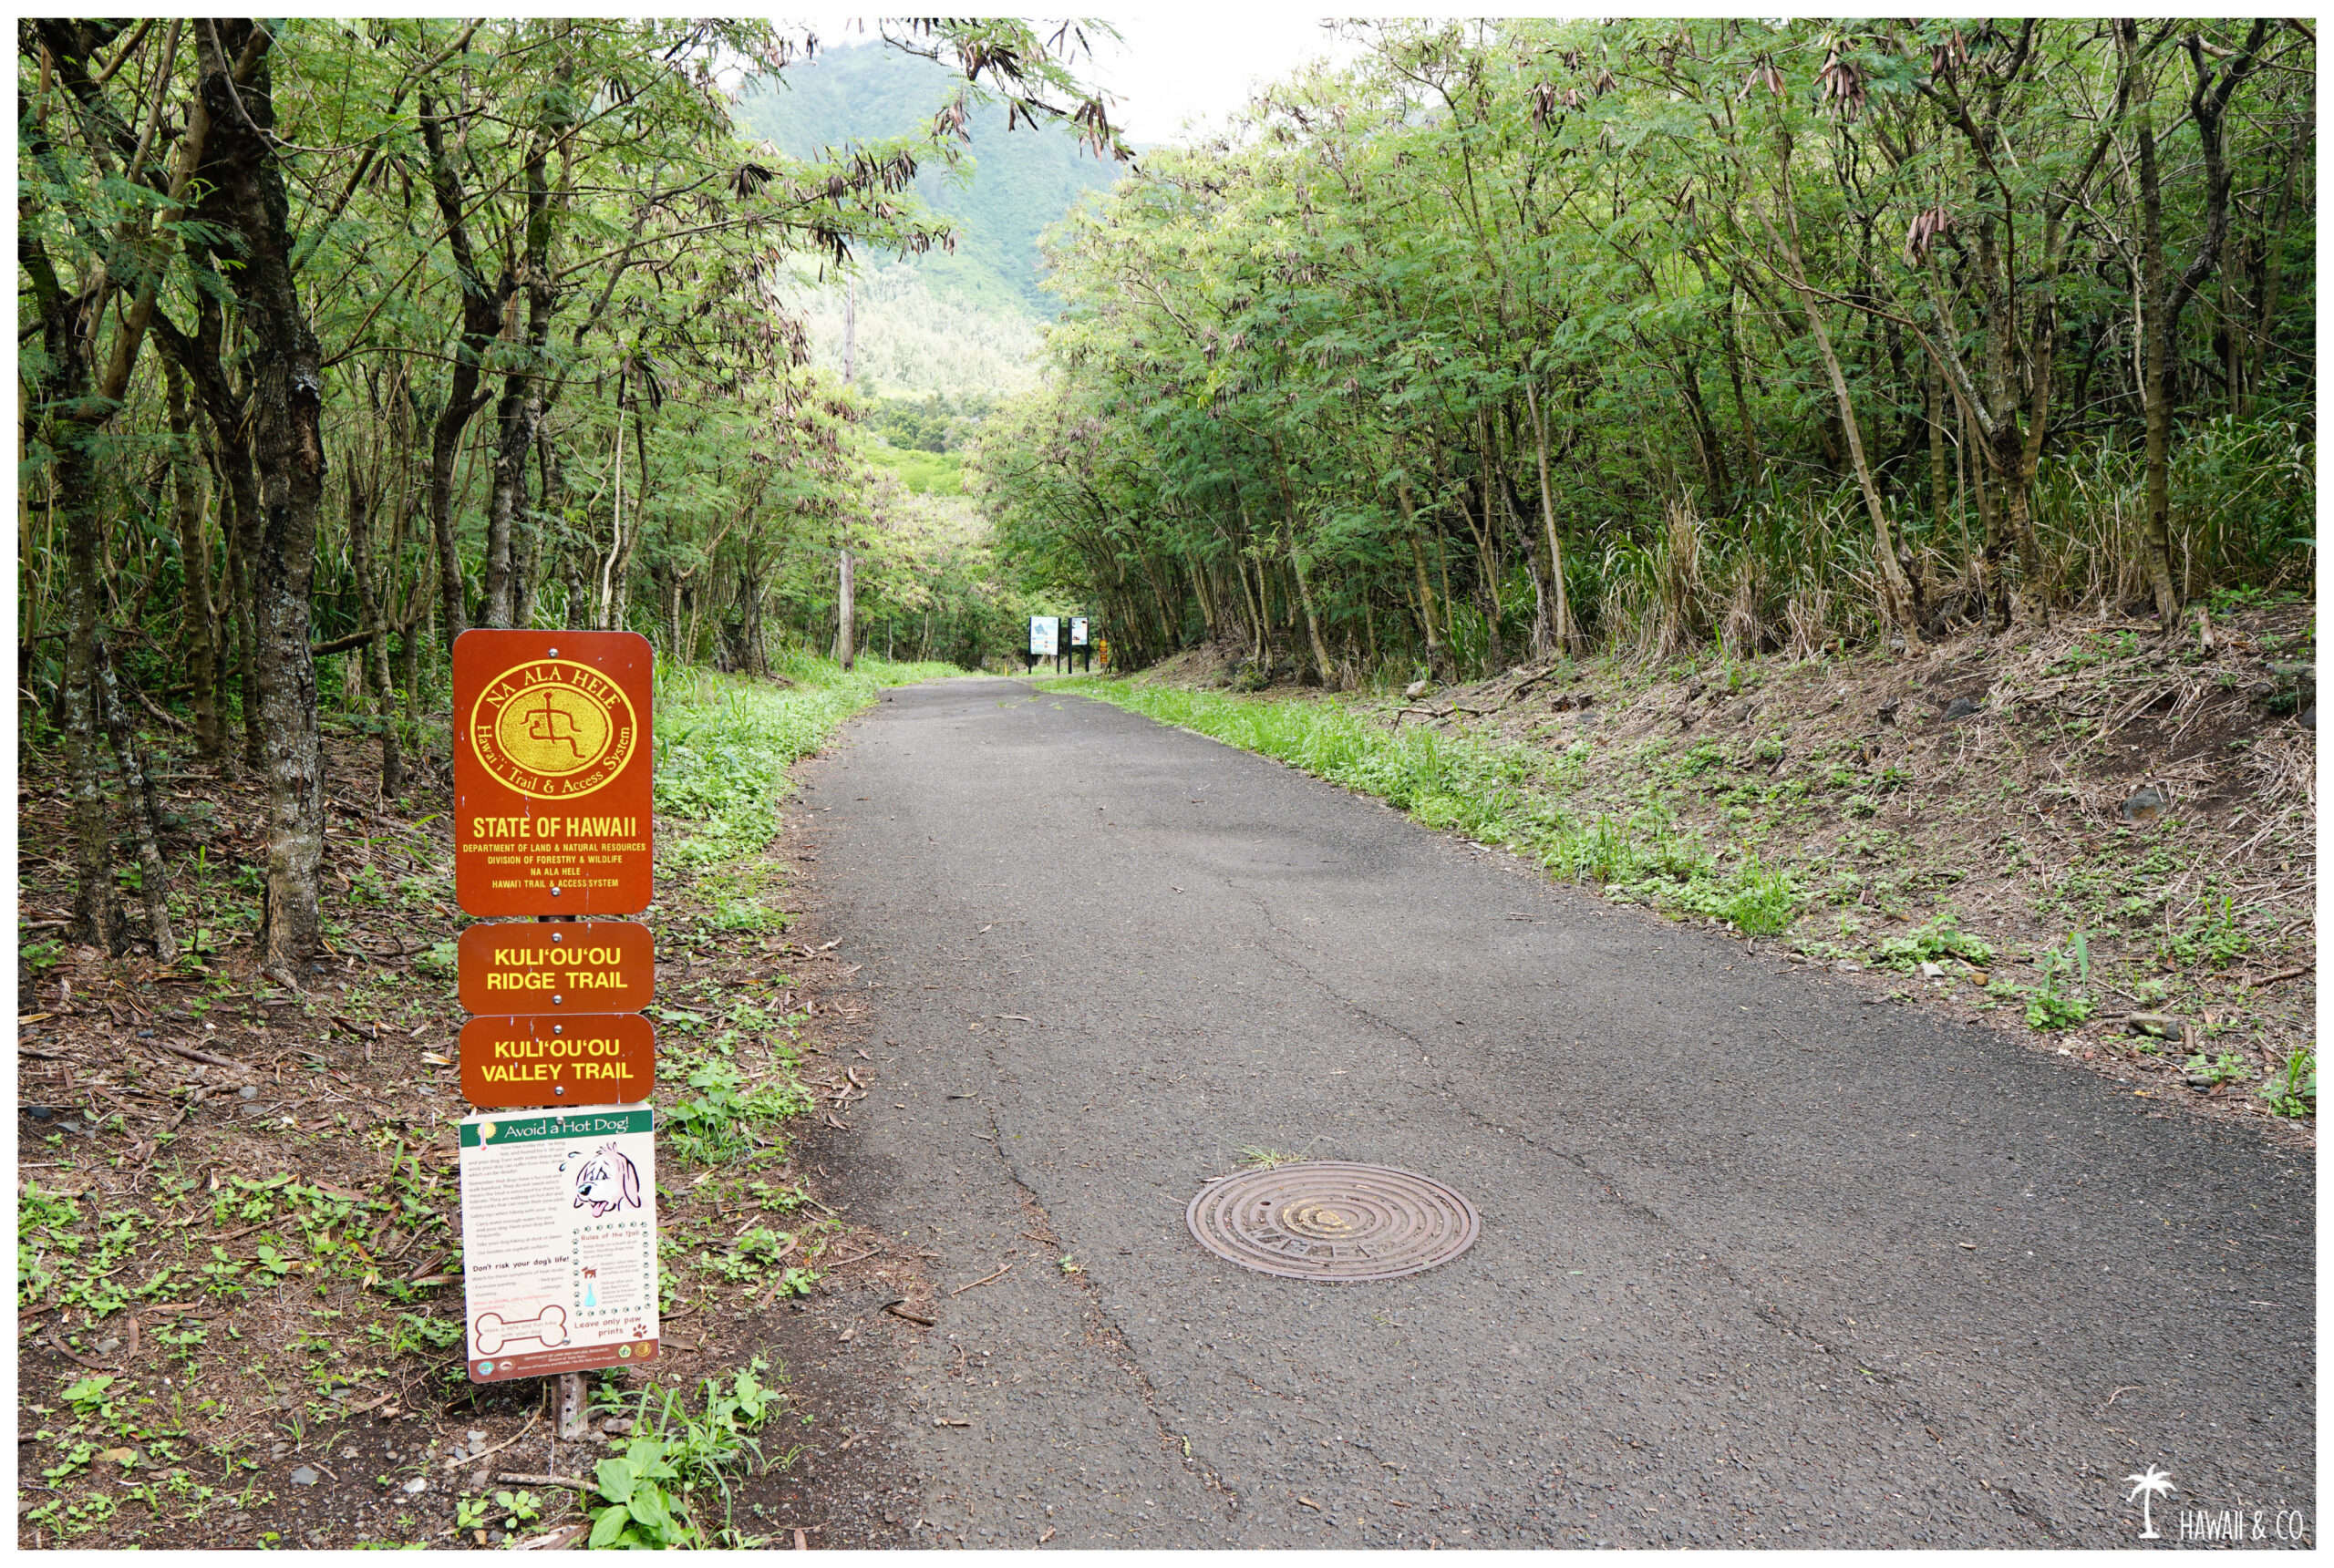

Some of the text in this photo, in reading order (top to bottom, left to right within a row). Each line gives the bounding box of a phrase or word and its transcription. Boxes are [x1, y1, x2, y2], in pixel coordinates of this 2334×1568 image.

[486, 665, 620, 709] NA ALA HELE
[509, 768, 538, 790] Trail
[543, 780, 554, 793] &
[562, 771, 604, 793] Access
[604, 727, 629, 770] System
[473, 817, 635, 837] STATE OF HAWAII
[463, 844, 514, 852] DEPARTMENT
[563, 843, 598, 851] NATURAL
[602, 843, 645, 851] RESOURCES
[488, 856, 521, 864] DIVISION
[524, 856, 533, 864] OF
[537, 856, 575, 864] FORESTRY
[588, 879, 618, 887] SYSTEM
[488, 972, 627, 989] RIDGE TRAIL
[481, 1063, 634, 1082] VALLEY TRAIL
[505, 1116, 628, 1138] Avoid a Hot Dog!
[473, 1264, 491, 1272] Don't
[496, 1262, 510, 1270] risk
[513, 1261, 530, 1269] your
[574, 1317, 641, 1329] Leave only paw
[598, 1328, 624, 1338] prints
